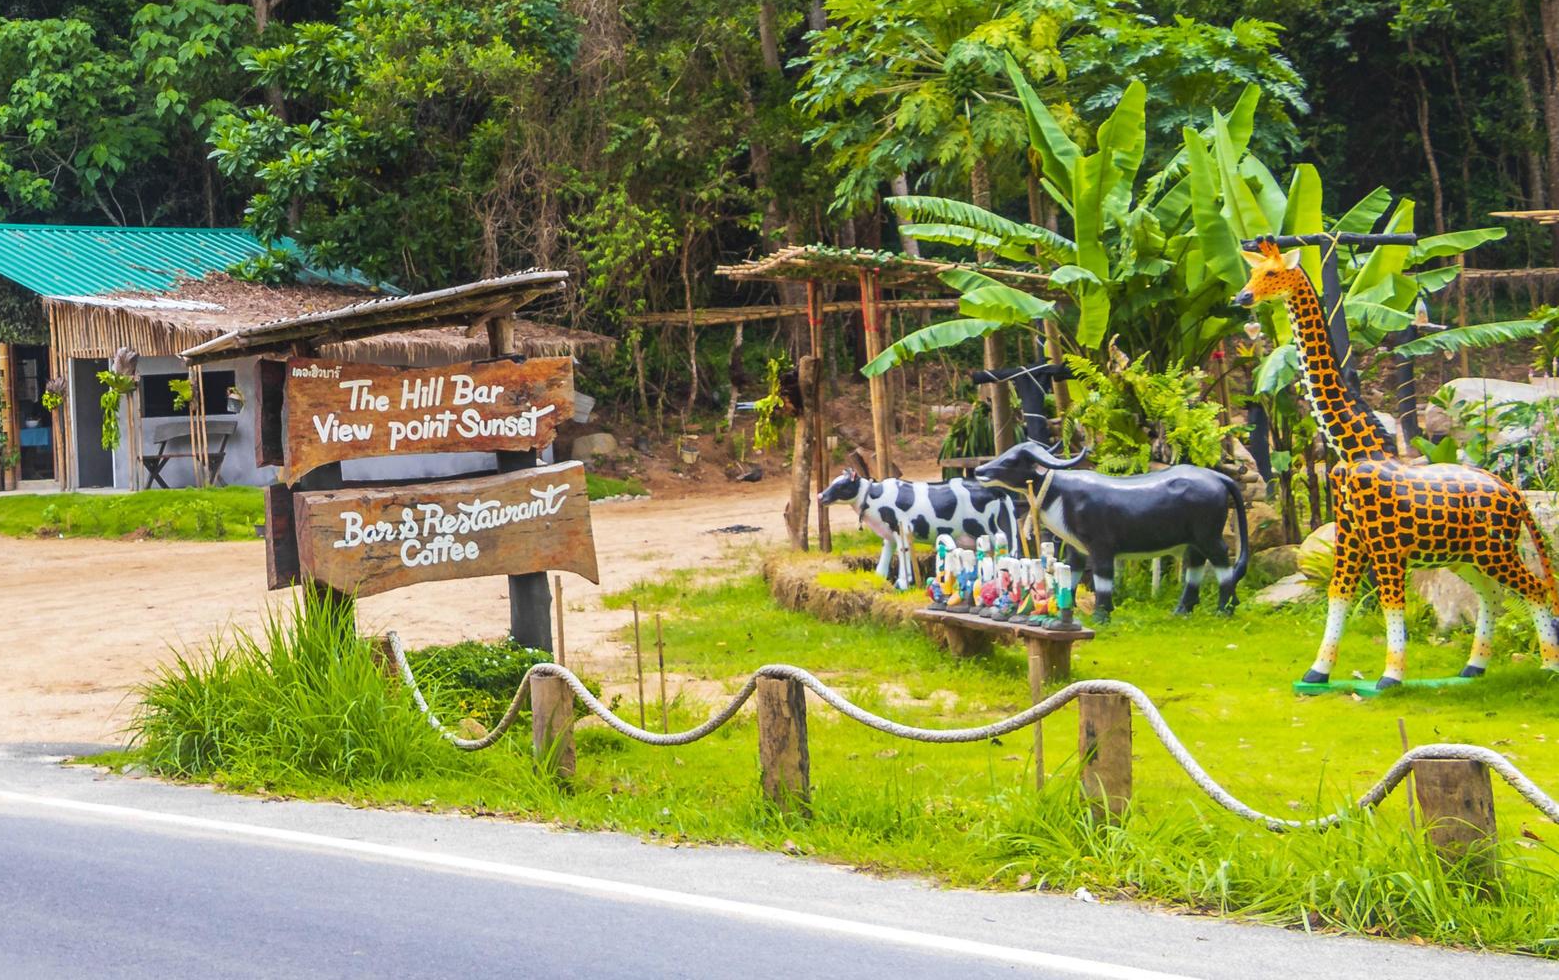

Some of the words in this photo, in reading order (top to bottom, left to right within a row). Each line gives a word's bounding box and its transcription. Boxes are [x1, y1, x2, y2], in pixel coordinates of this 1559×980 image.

[339, 380, 389, 411] The
[401, 377, 444, 410] Hill
[451, 375, 504, 405] Bar
[313, 413, 373, 443] View
[389, 410, 457, 450] point
[456, 404, 555, 438] Sunset
[334, 512, 396, 548] Bar
[417, 484, 570, 536] Restaurant
[401, 535, 479, 567] Coffee
